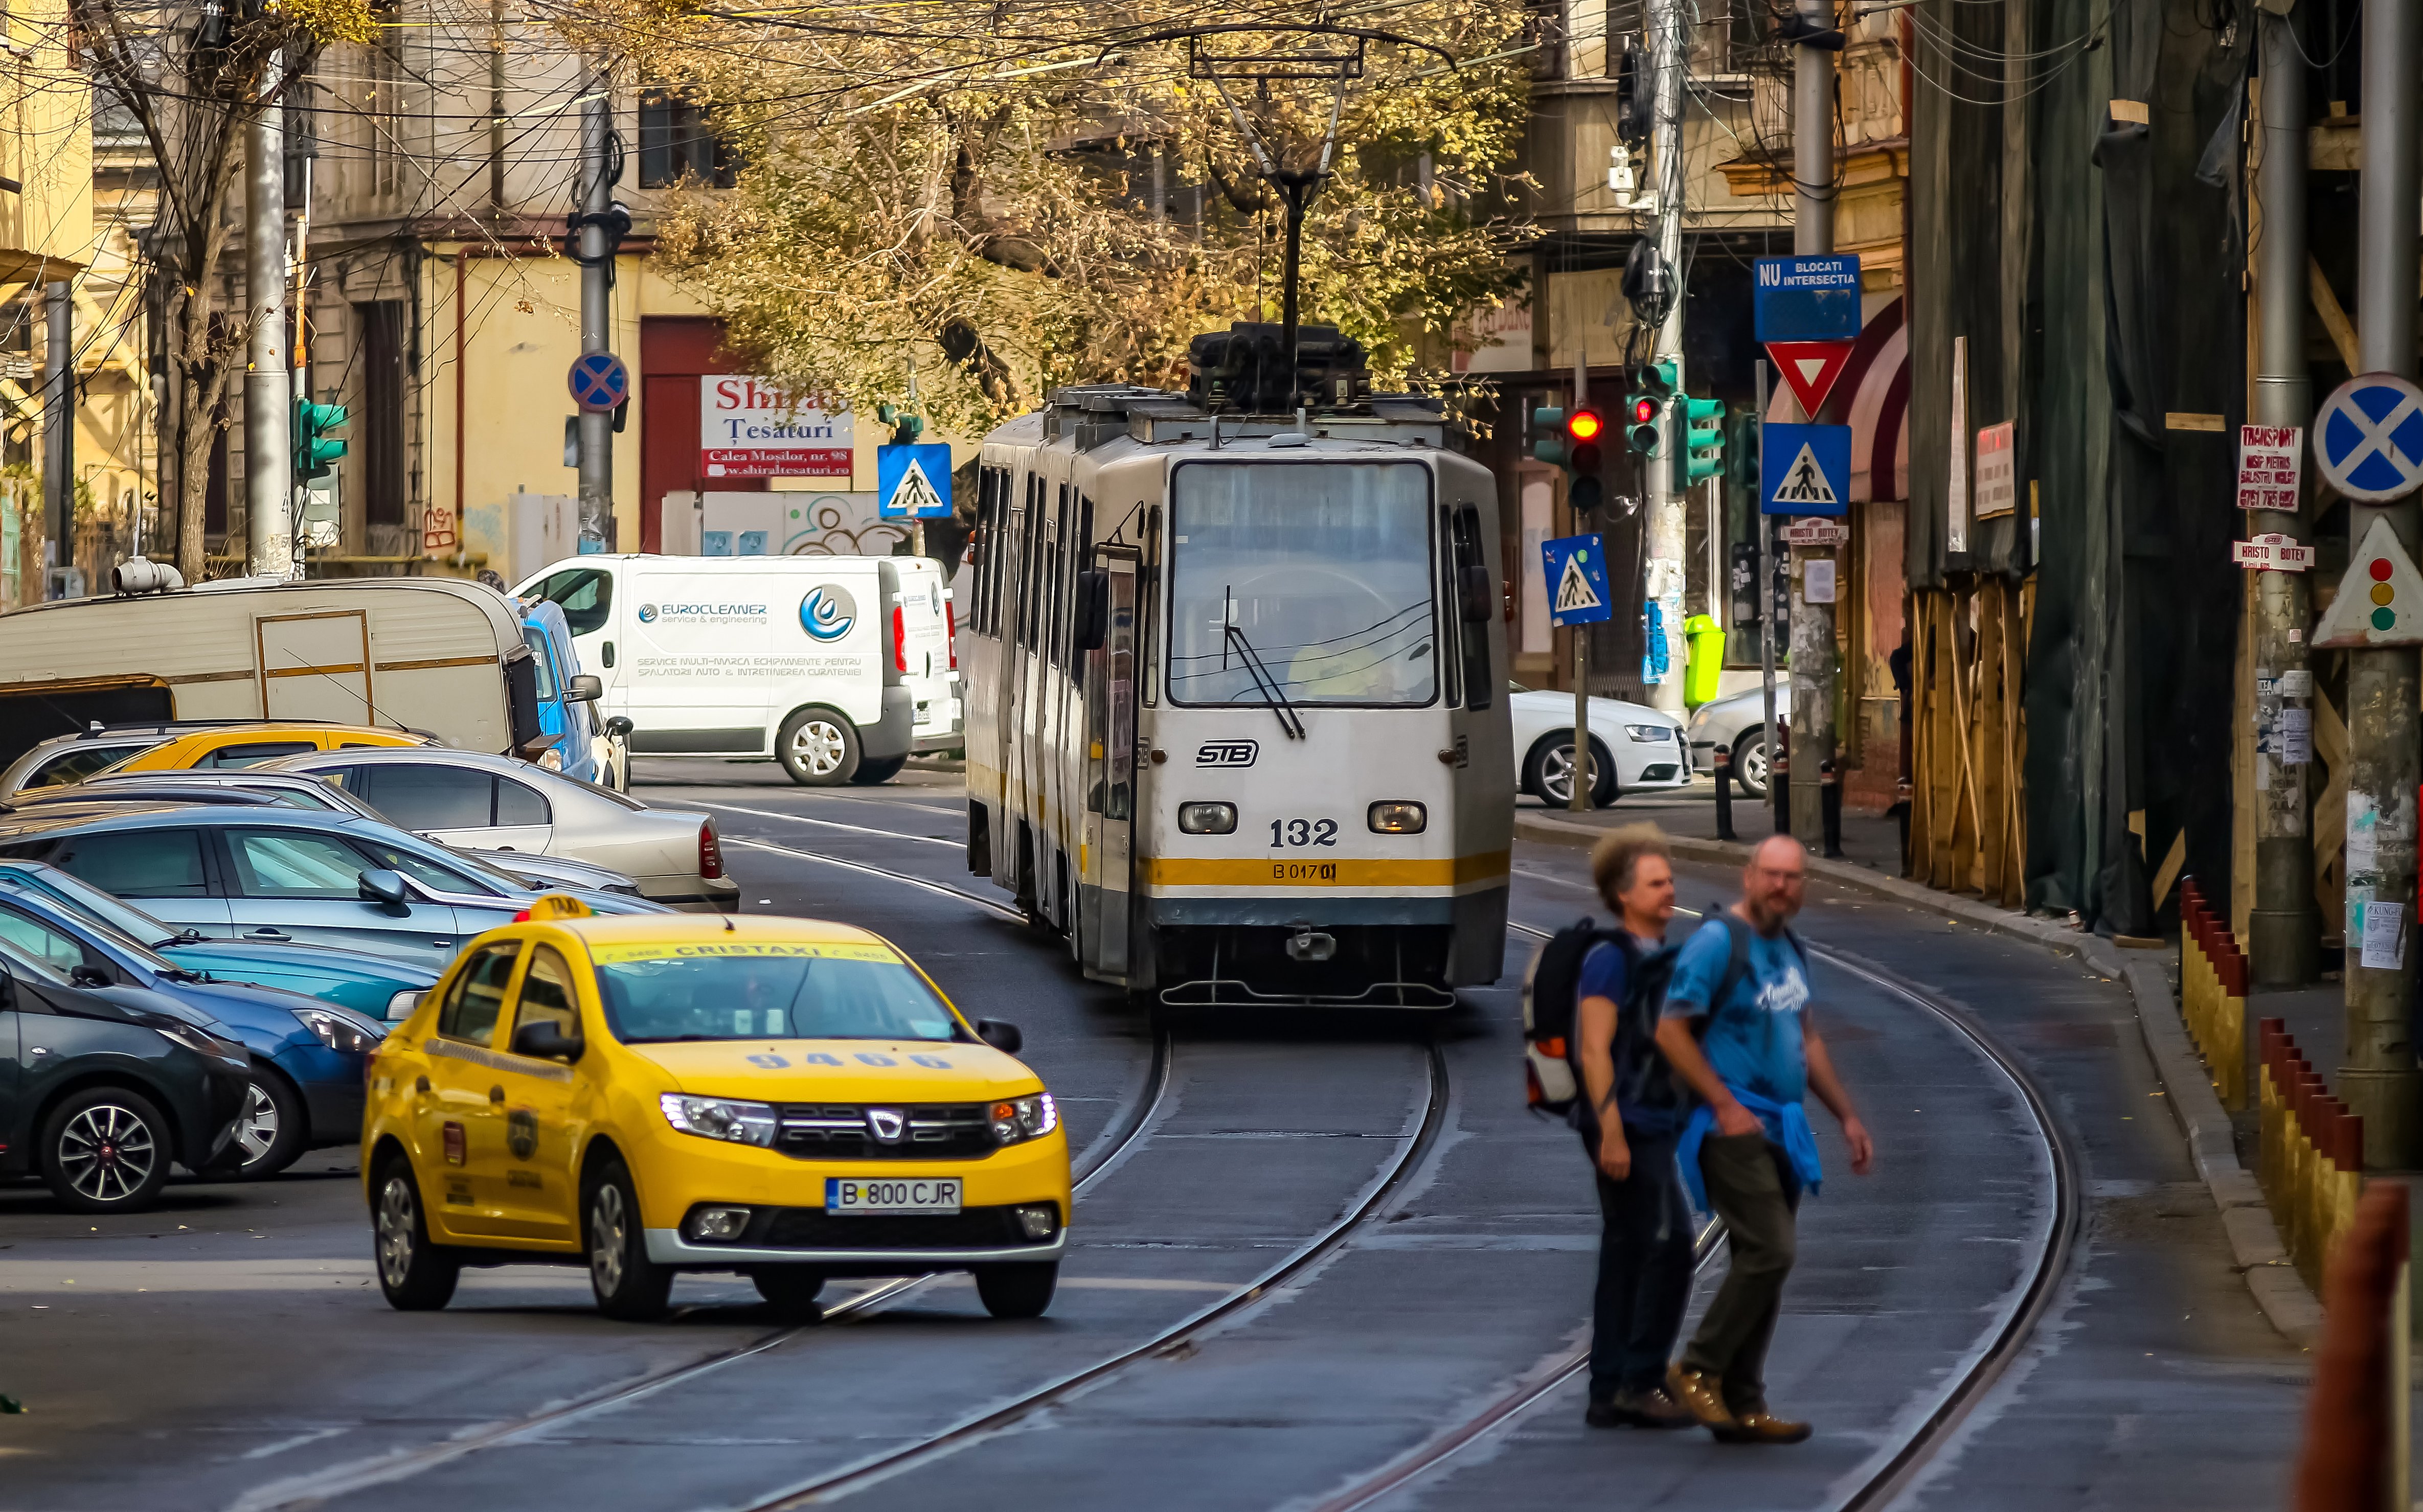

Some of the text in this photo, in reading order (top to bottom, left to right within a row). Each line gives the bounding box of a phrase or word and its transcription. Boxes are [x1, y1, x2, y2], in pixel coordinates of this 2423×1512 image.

[1760, 264, 1780, 286] NU
[709, 450, 747, 461] Calea
[831, 450, 847, 460] 98
[2243, 545, 2305, 561] HRISTO BOTEV
[662, 604, 767, 614] EUROCLEANER
[710, 615, 767, 625] engineering
[638, 657, 677, 666] SERVICE
[681, 657, 750, 666] MULTI-MARCA
[825, 657, 862, 666] PENTRU
[1196, 744, 1254, 763] STB
[1271, 818, 1339, 848] 132
[1274, 864, 1285, 879] B
[547, 898, 579, 914] TAXI
[675, 945, 821, 956] CRISTAXI
[844, 1183, 858, 1204] B
[868, 1183, 908, 1204] 800
[913, 1183, 956, 1204] CJR
